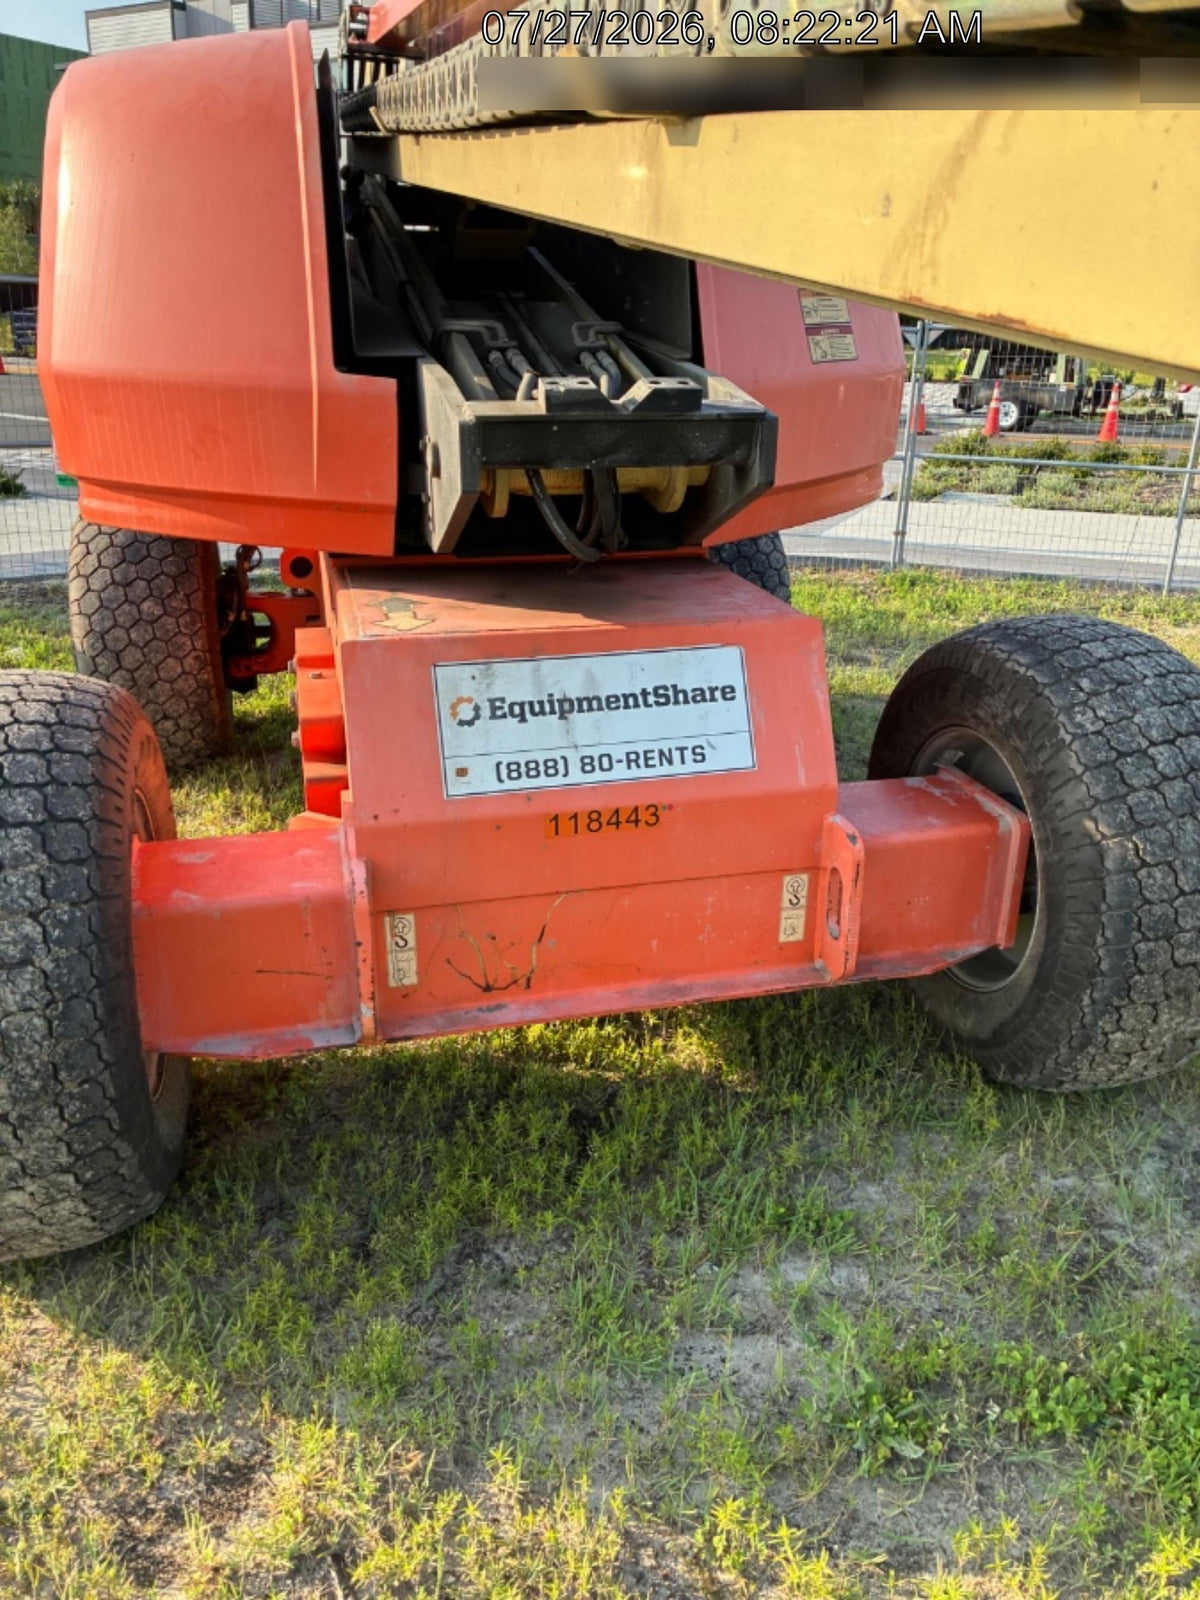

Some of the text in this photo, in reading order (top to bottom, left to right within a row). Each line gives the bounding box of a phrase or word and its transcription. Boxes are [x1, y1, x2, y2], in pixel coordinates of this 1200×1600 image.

[488, 683, 737, 723] EquipmentShare
[495, 744, 707, 783] (888) 80-RENTS
[548, 803, 661, 836] 118443
